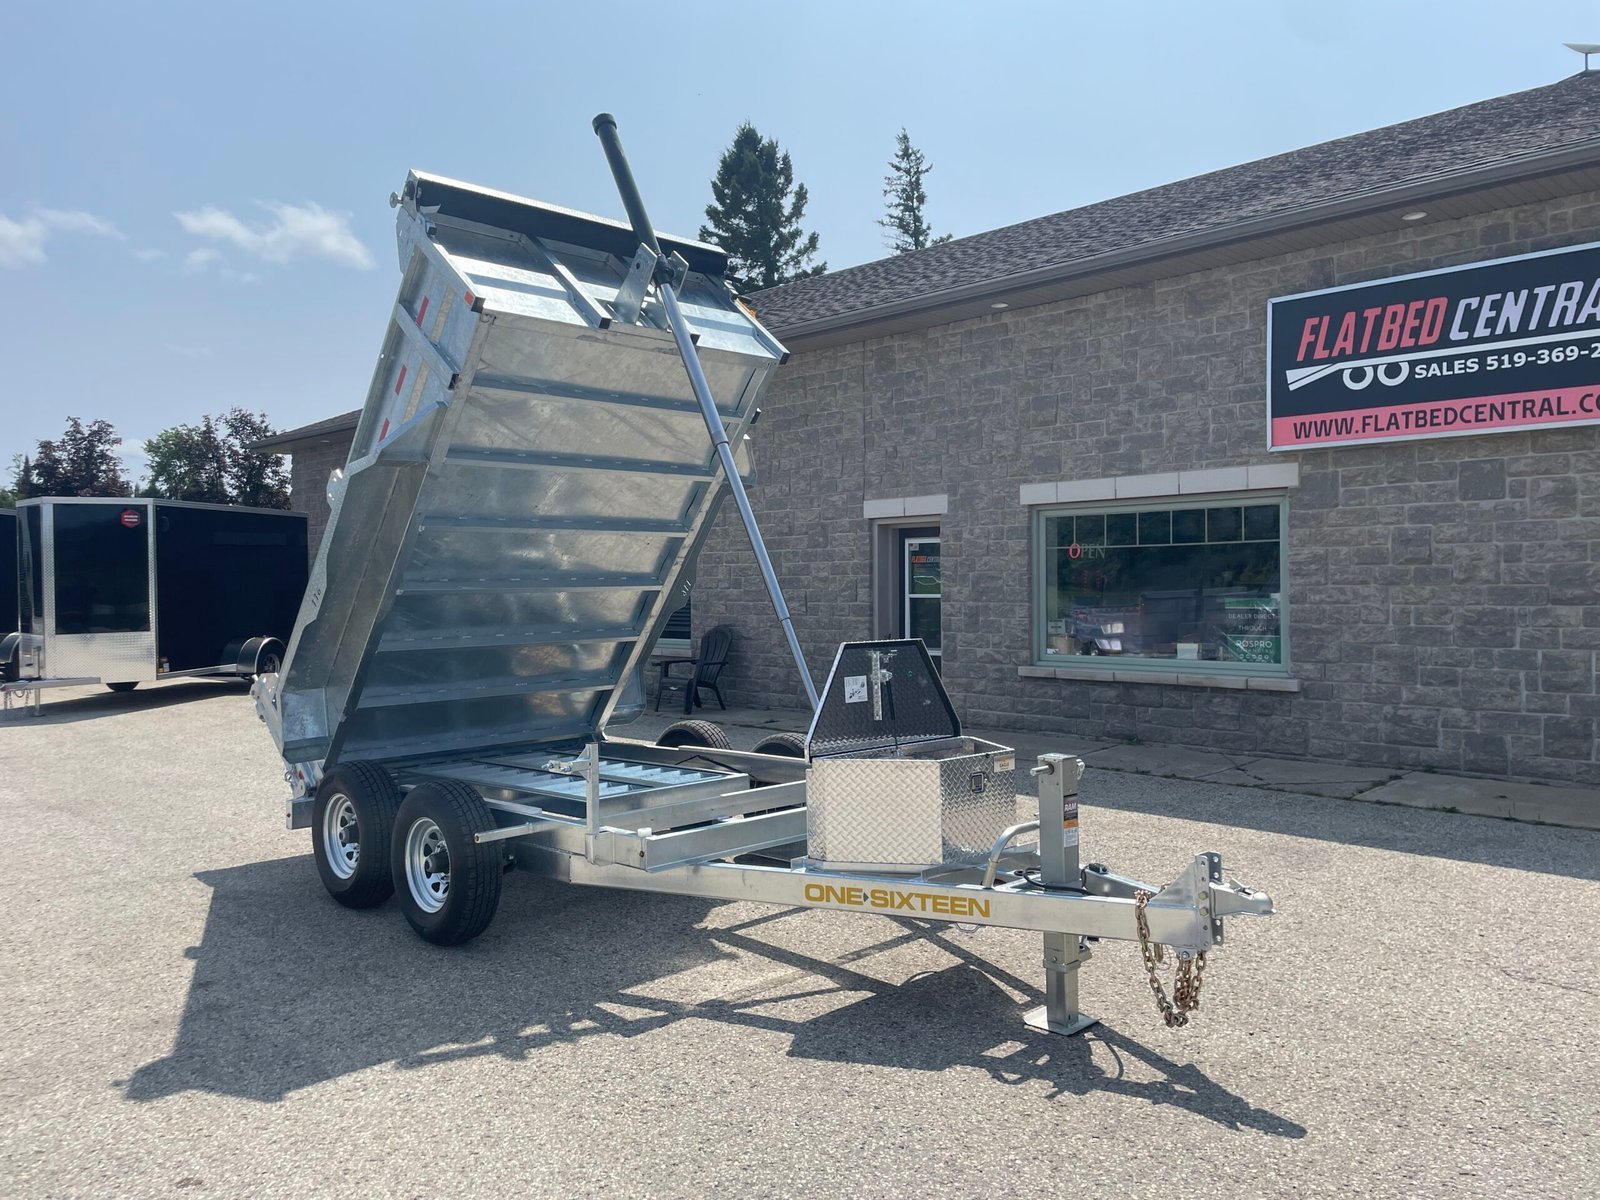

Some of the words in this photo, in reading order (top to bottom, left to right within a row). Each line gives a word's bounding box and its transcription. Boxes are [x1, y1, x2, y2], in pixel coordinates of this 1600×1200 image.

[1296, 297, 1448, 362] FLATBED
[1414, 358, 1479, 379] SALES
[1486, 342, 1600, 371] 519-369-2
[1293, 392, 1600, 439] WWW.FLATBEDCENTRAL.C
[1069, 543, 1105, 559] OPEN
[1064, 802, 1077, 811] RAM
[804, 883, 864, 906] ONE
[870, 889, 990, 918] SIXTEEN
